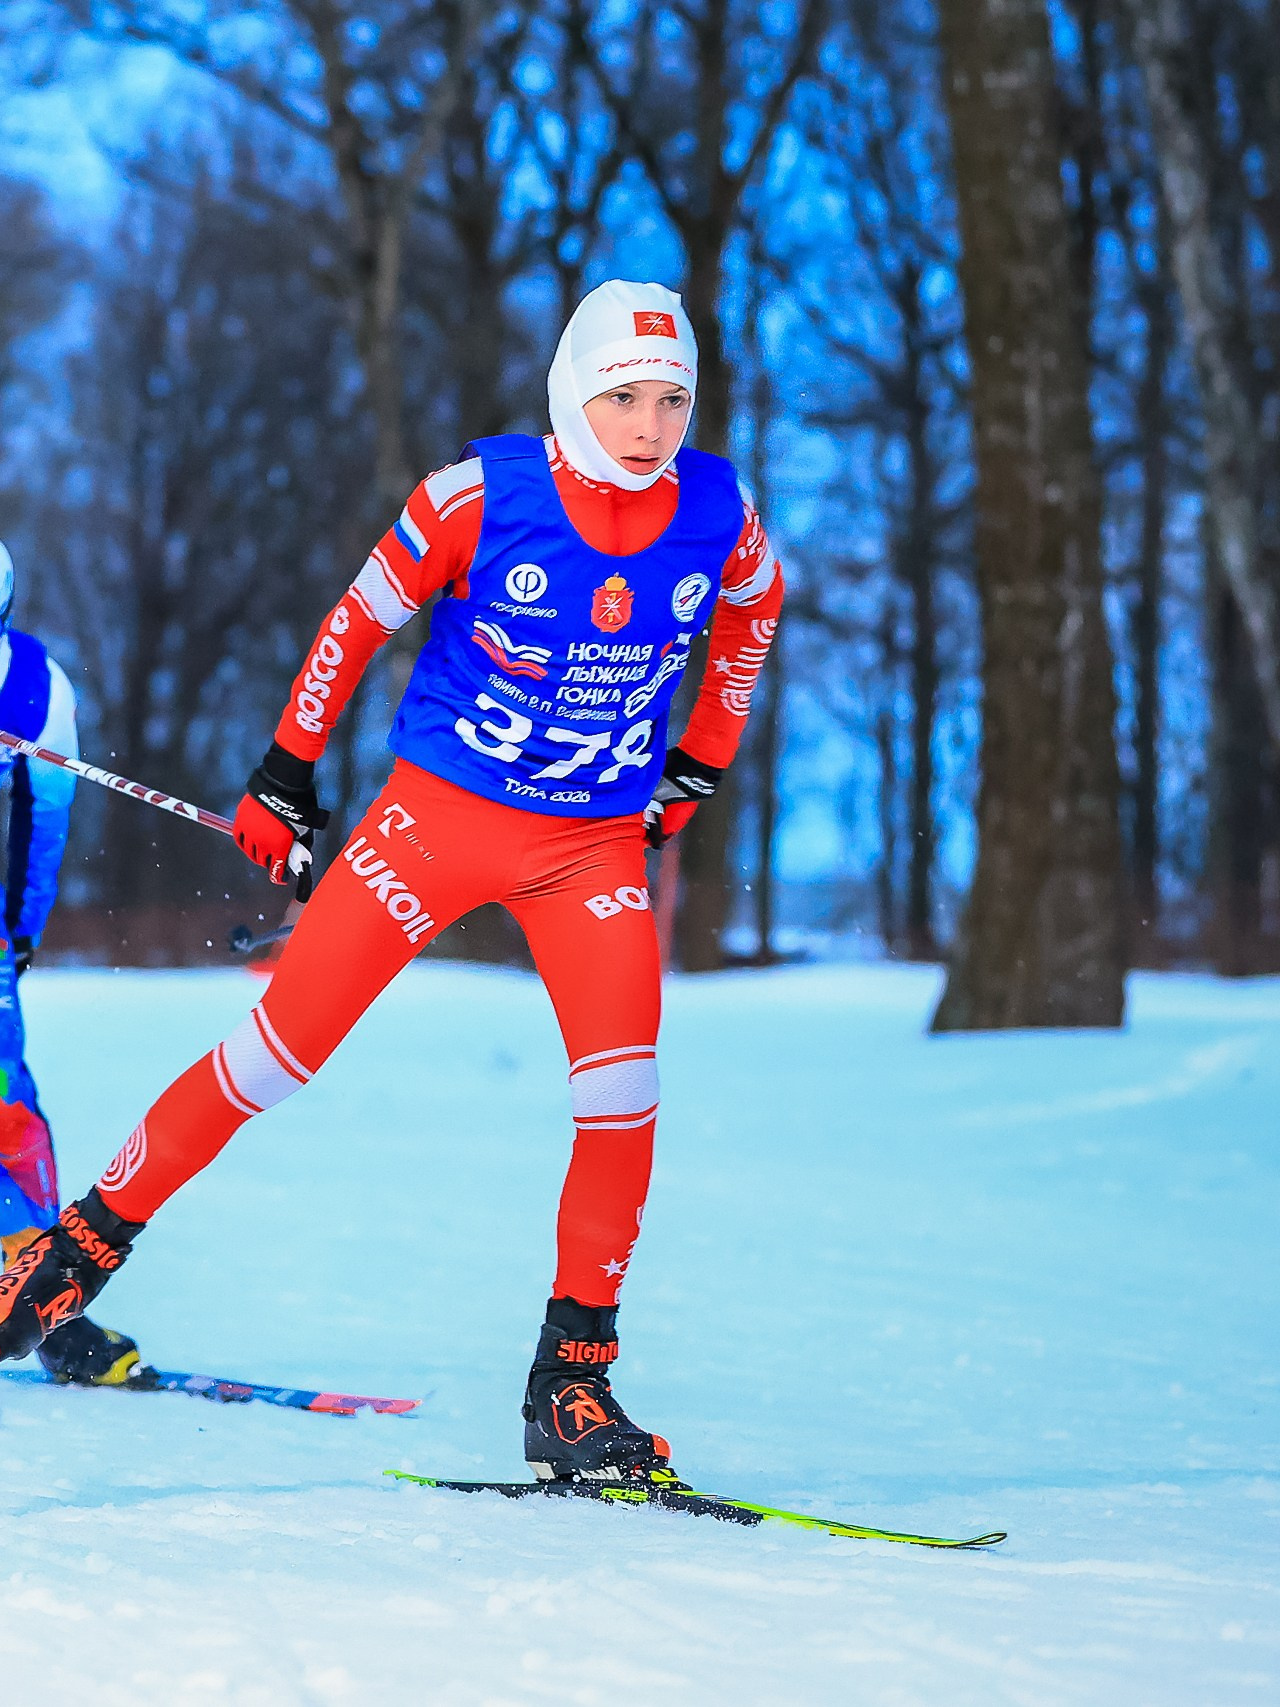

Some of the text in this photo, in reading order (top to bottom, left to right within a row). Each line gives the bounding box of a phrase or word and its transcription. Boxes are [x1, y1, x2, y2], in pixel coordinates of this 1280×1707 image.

[566, 642, 654, 663] НОЧНАЯ
[295, 634, 345, 734] BOSCO
[504, 778, 592, 803] ТУЛА 2026
[343, 836, 436, 945] LUKOIL
[583, 884, 651, 921] BO
